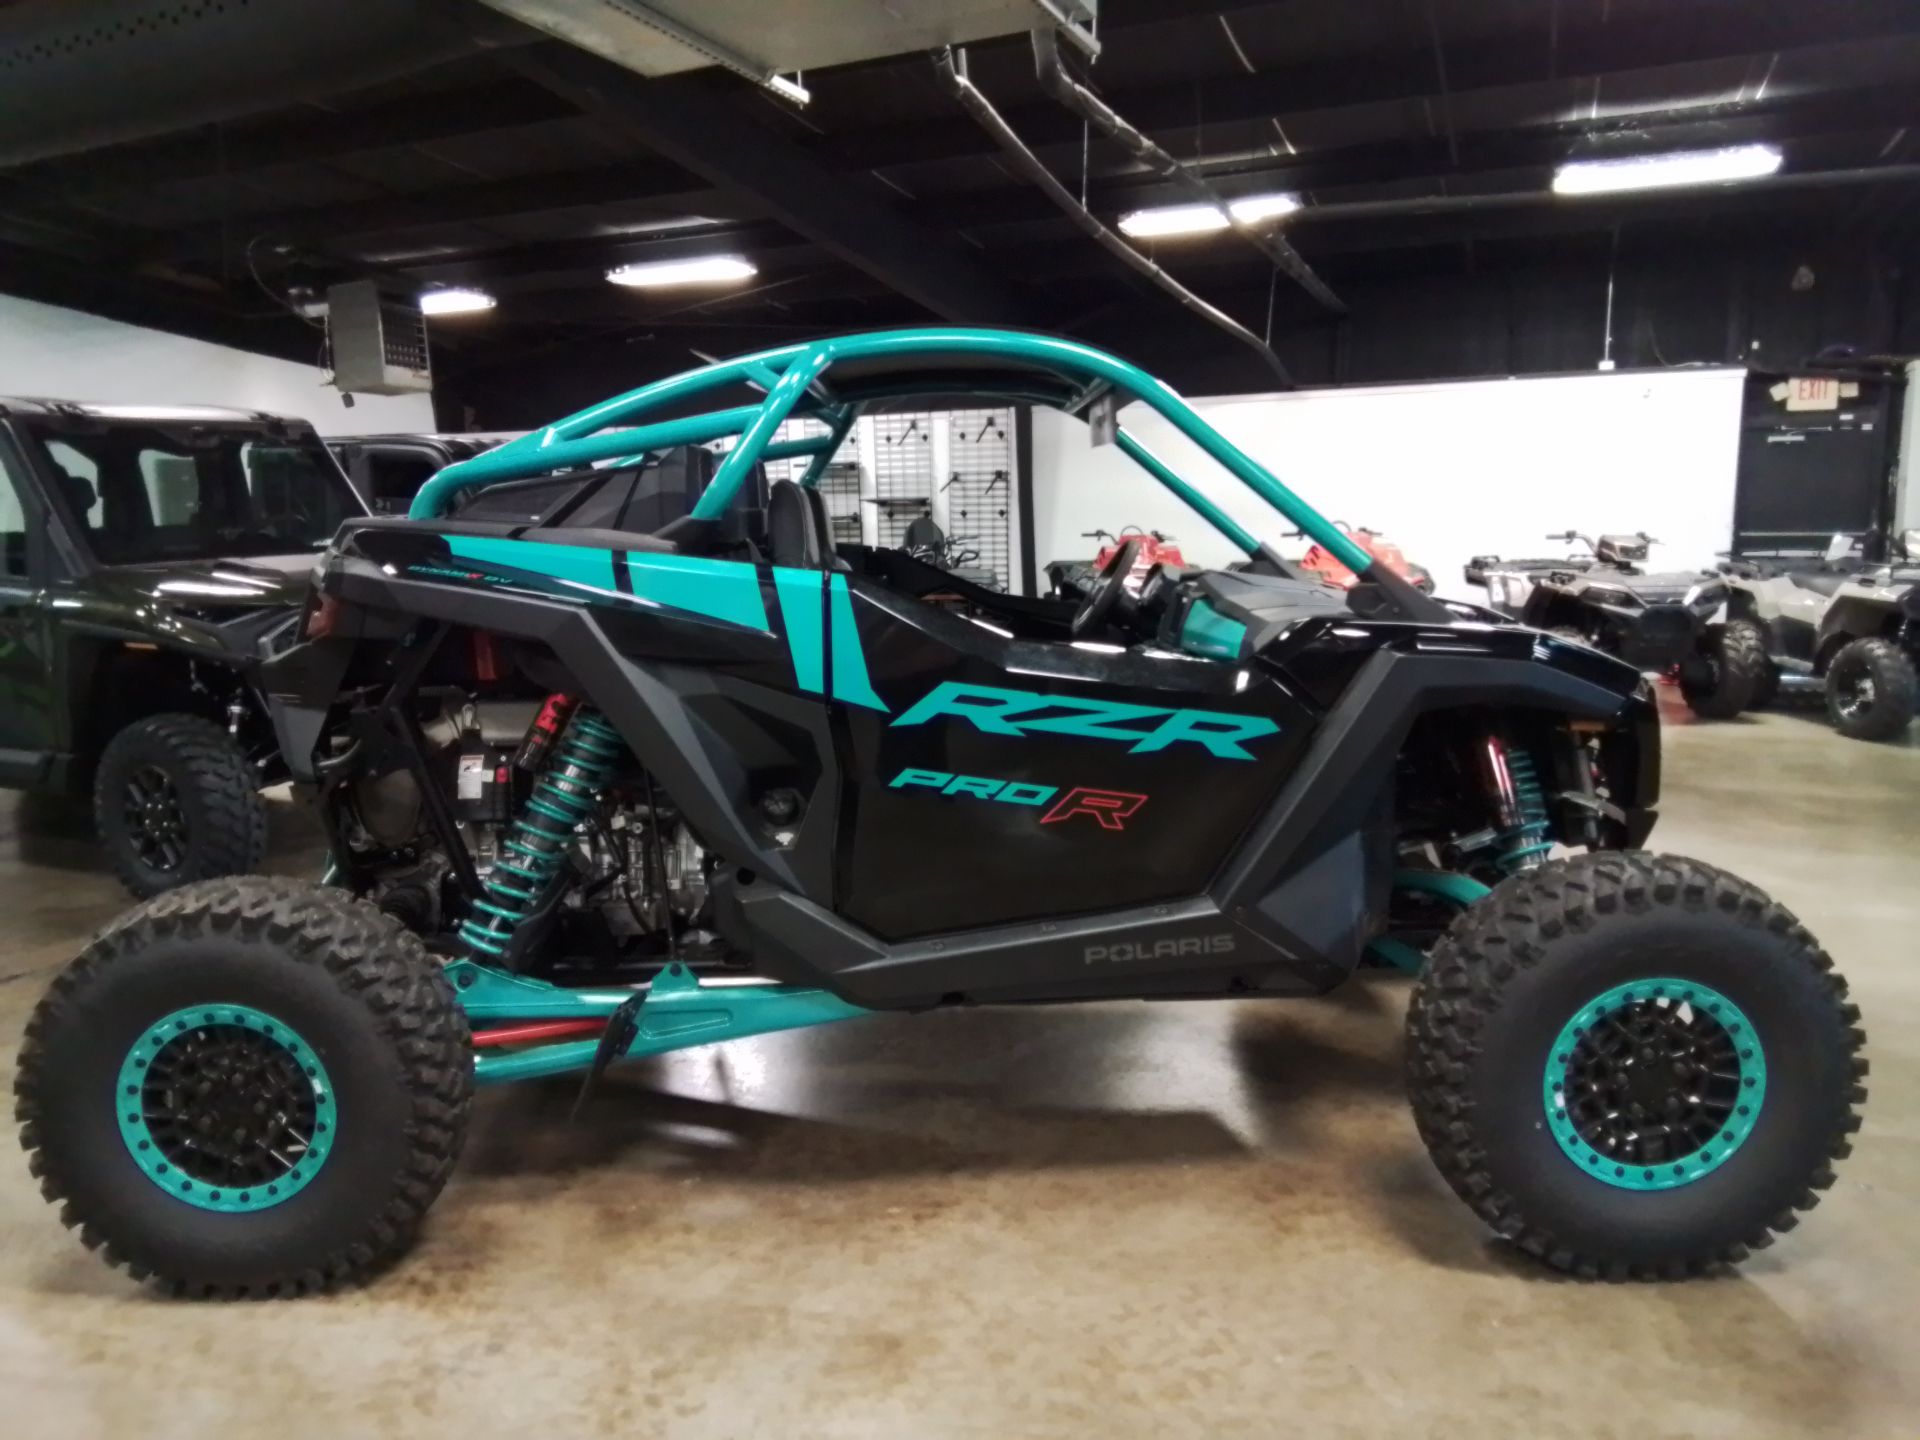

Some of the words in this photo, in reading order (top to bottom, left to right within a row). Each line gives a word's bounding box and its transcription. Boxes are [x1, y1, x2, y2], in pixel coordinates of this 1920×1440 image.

[1799, 379, 1828, 400] EXIT
[889, 681, 1281, 761] RZR
[888, 768, 1059, 806] PRO
[1040, 787, 1149, 830] R
[1084, 934, 1236, 965] POLARIS
